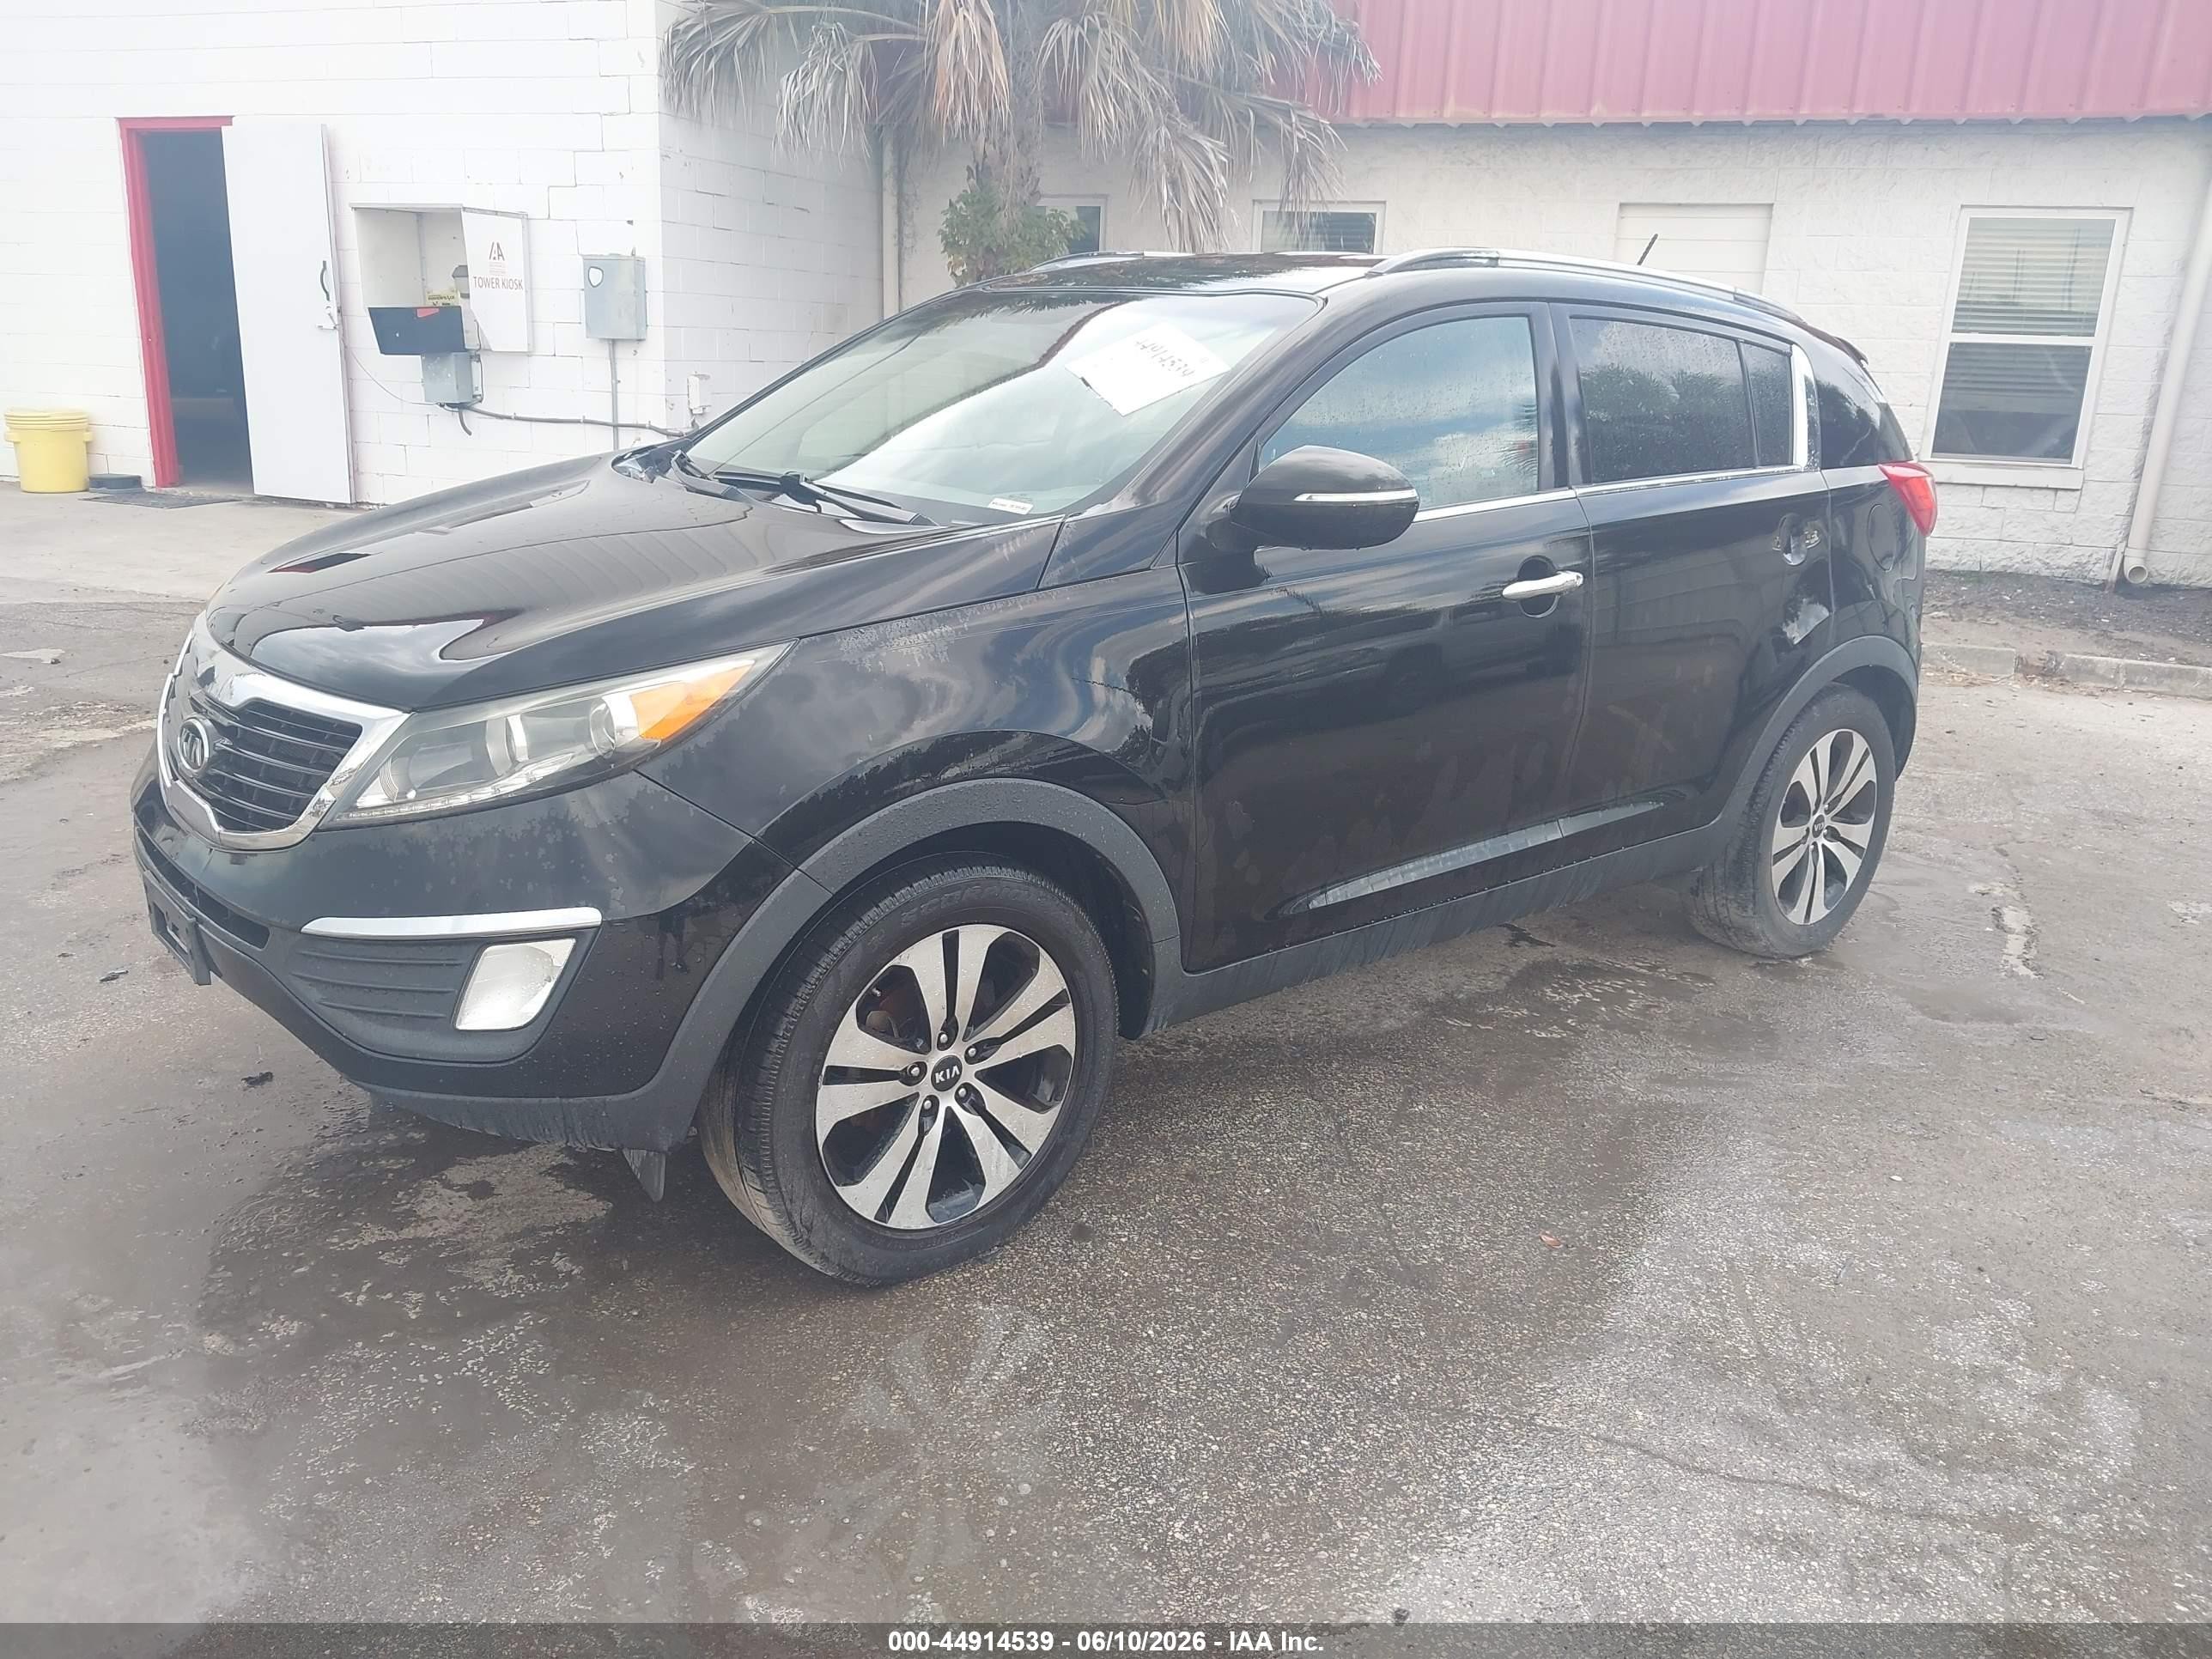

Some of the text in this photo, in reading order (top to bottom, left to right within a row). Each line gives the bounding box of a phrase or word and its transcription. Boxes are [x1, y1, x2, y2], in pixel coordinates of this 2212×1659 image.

[473, 276, 523, 290] TOWER KIOSK
[934, 1065, 960, 1084] KIA
